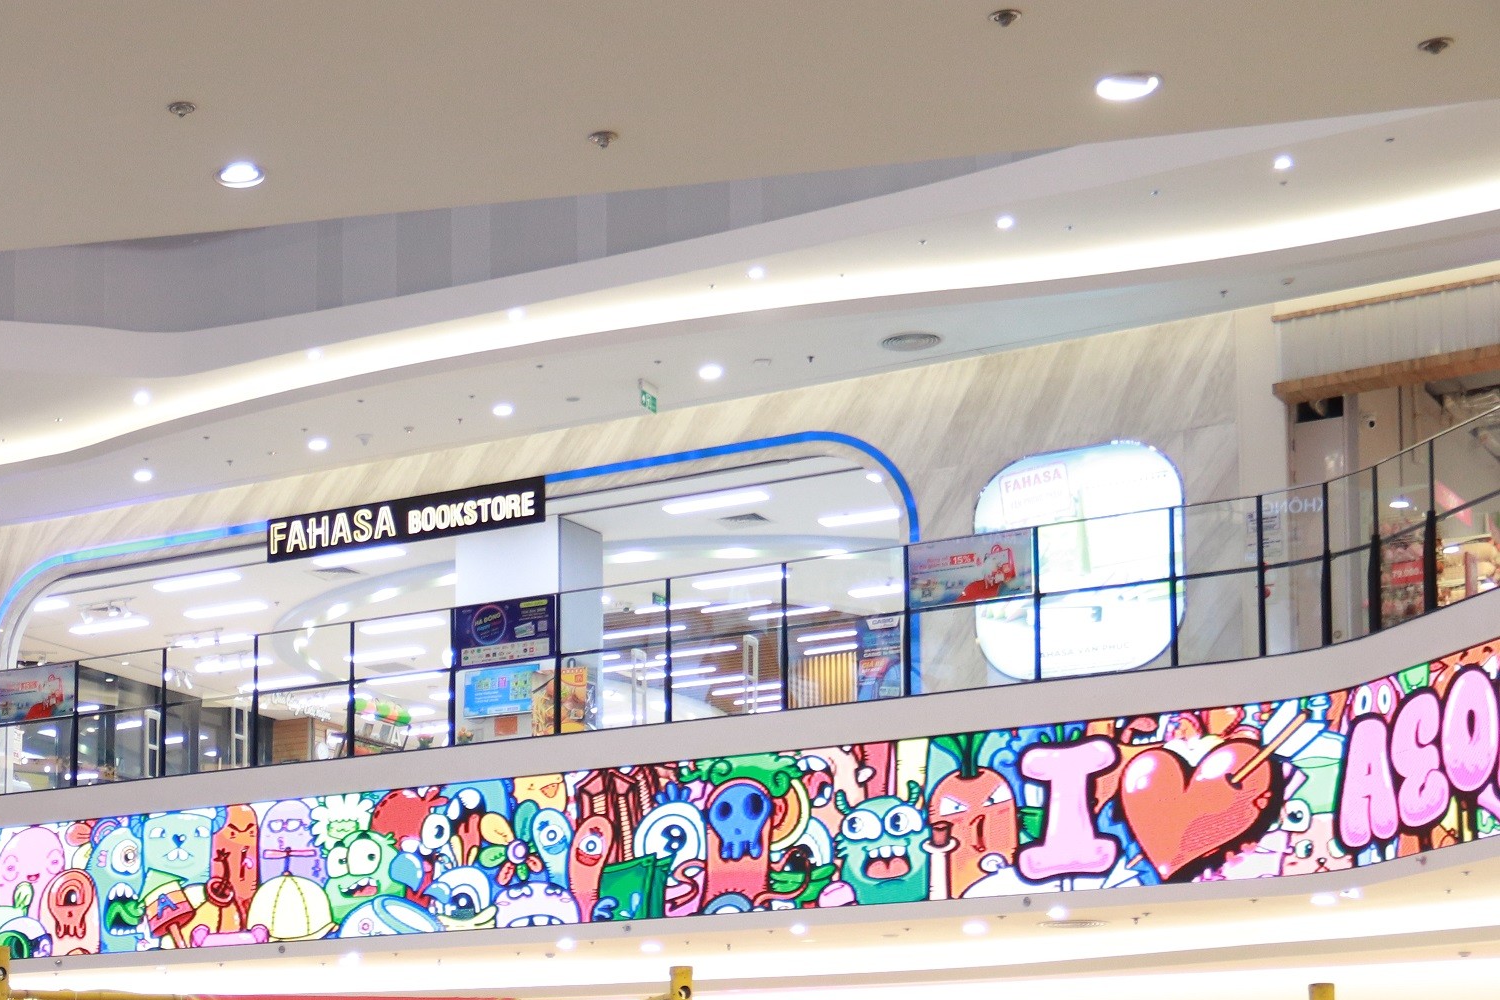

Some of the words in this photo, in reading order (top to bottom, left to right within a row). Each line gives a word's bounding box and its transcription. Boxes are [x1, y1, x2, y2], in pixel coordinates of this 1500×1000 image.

[270, 504, 396, 555] FAHASA
[407, 490, 534, 534] BOOKSTORE
[1004, 467, 1063, 494] FAHASA
[1021, 740, 1118, 879] I
[1339, 669, 1500, 848] AEO
